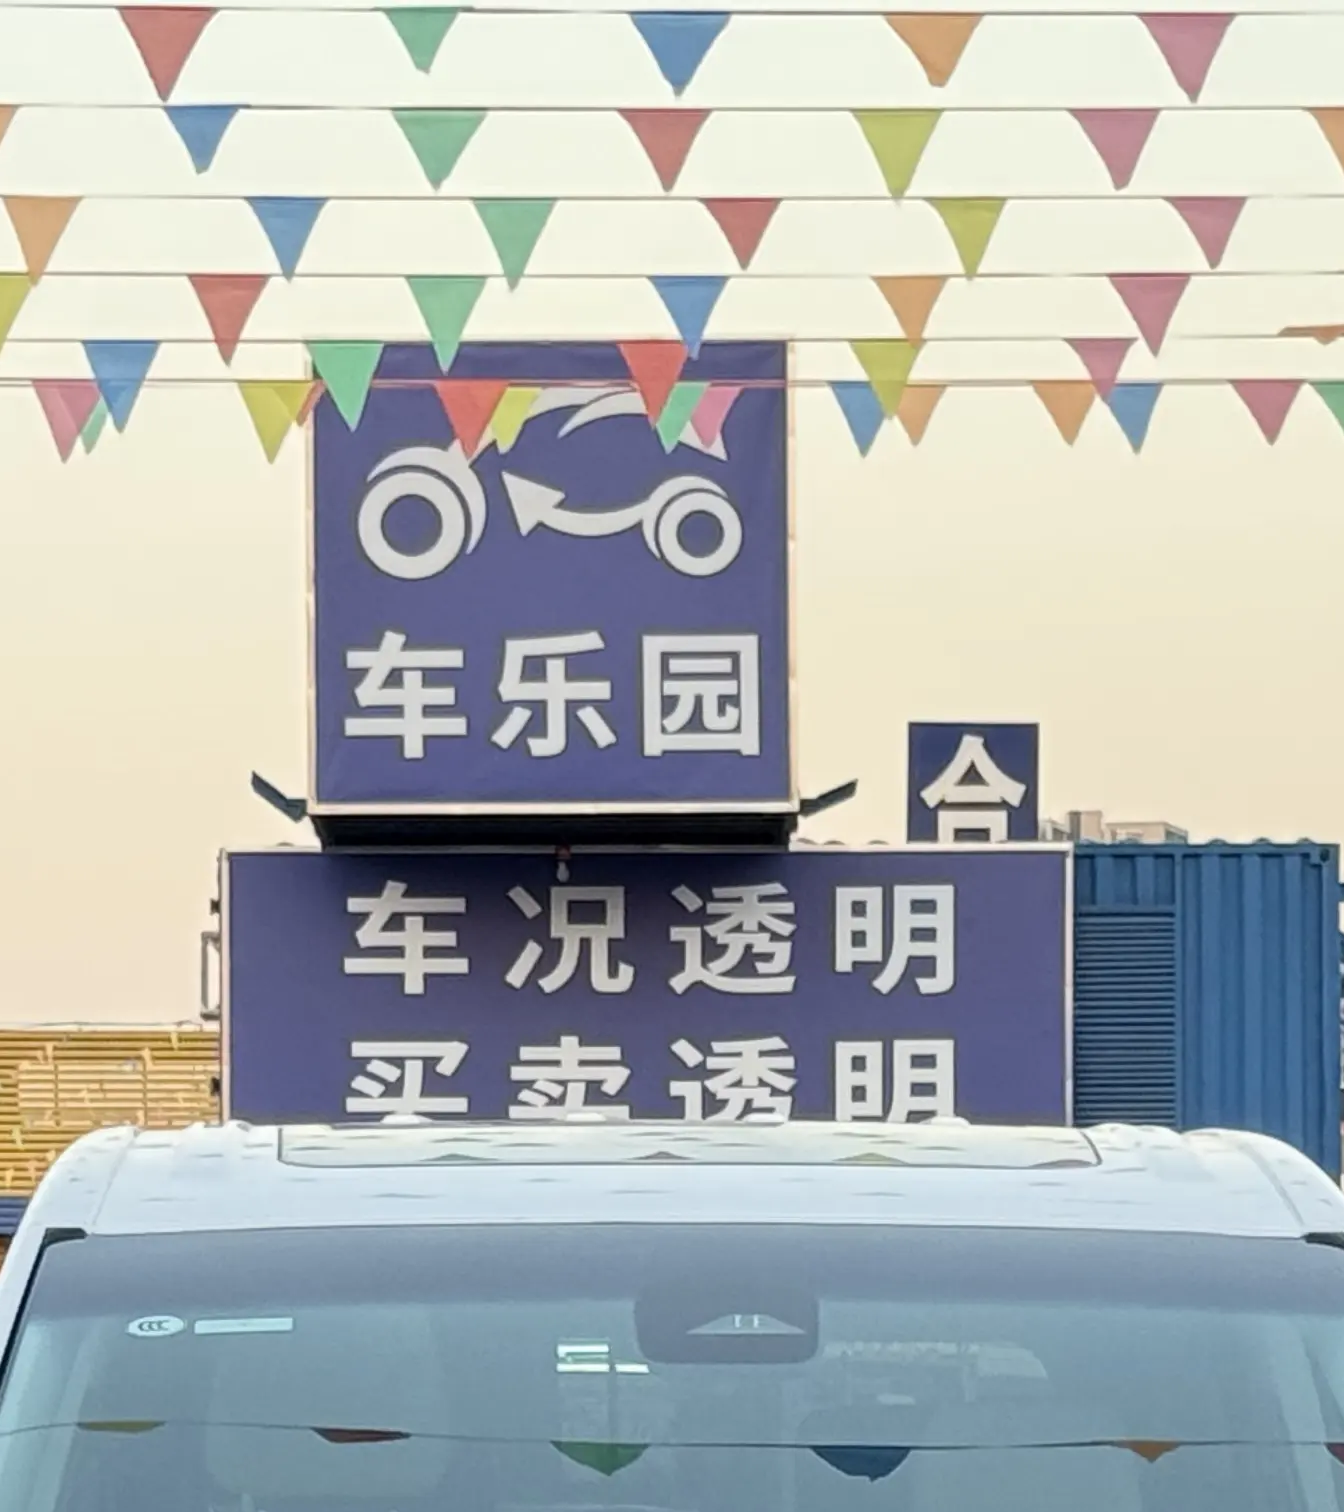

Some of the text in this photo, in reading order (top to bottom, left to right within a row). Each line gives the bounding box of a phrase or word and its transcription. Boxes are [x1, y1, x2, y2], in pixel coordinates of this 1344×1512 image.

[344, 631, 760, 759] 车乐园
[344, 880, 957, 994] 车况透明
[346, 1036, 957, 1123] 买卖透明
